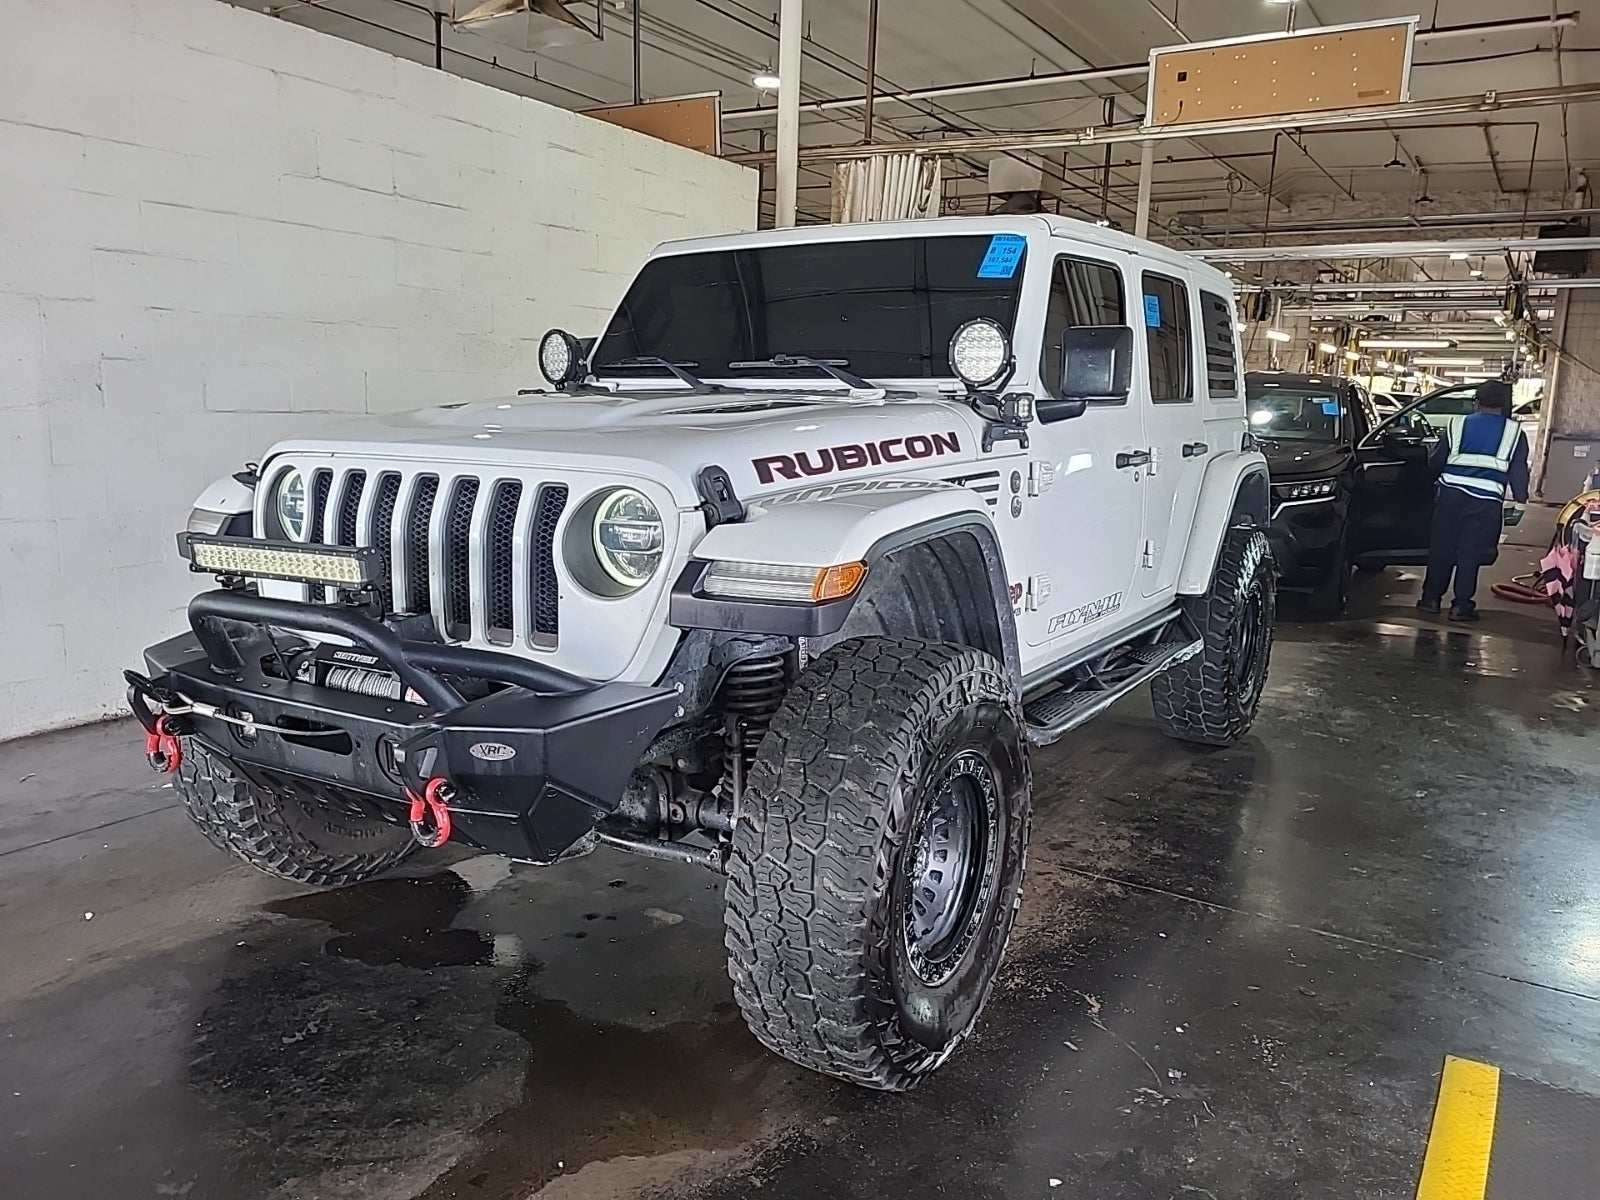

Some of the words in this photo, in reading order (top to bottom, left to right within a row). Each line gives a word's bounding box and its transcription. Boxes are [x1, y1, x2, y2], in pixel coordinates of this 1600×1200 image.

[1002, 247, 1018, 255] 154
[751, 431, 961, 485] RUBICON
[479, 744, 507, 757] XRC
